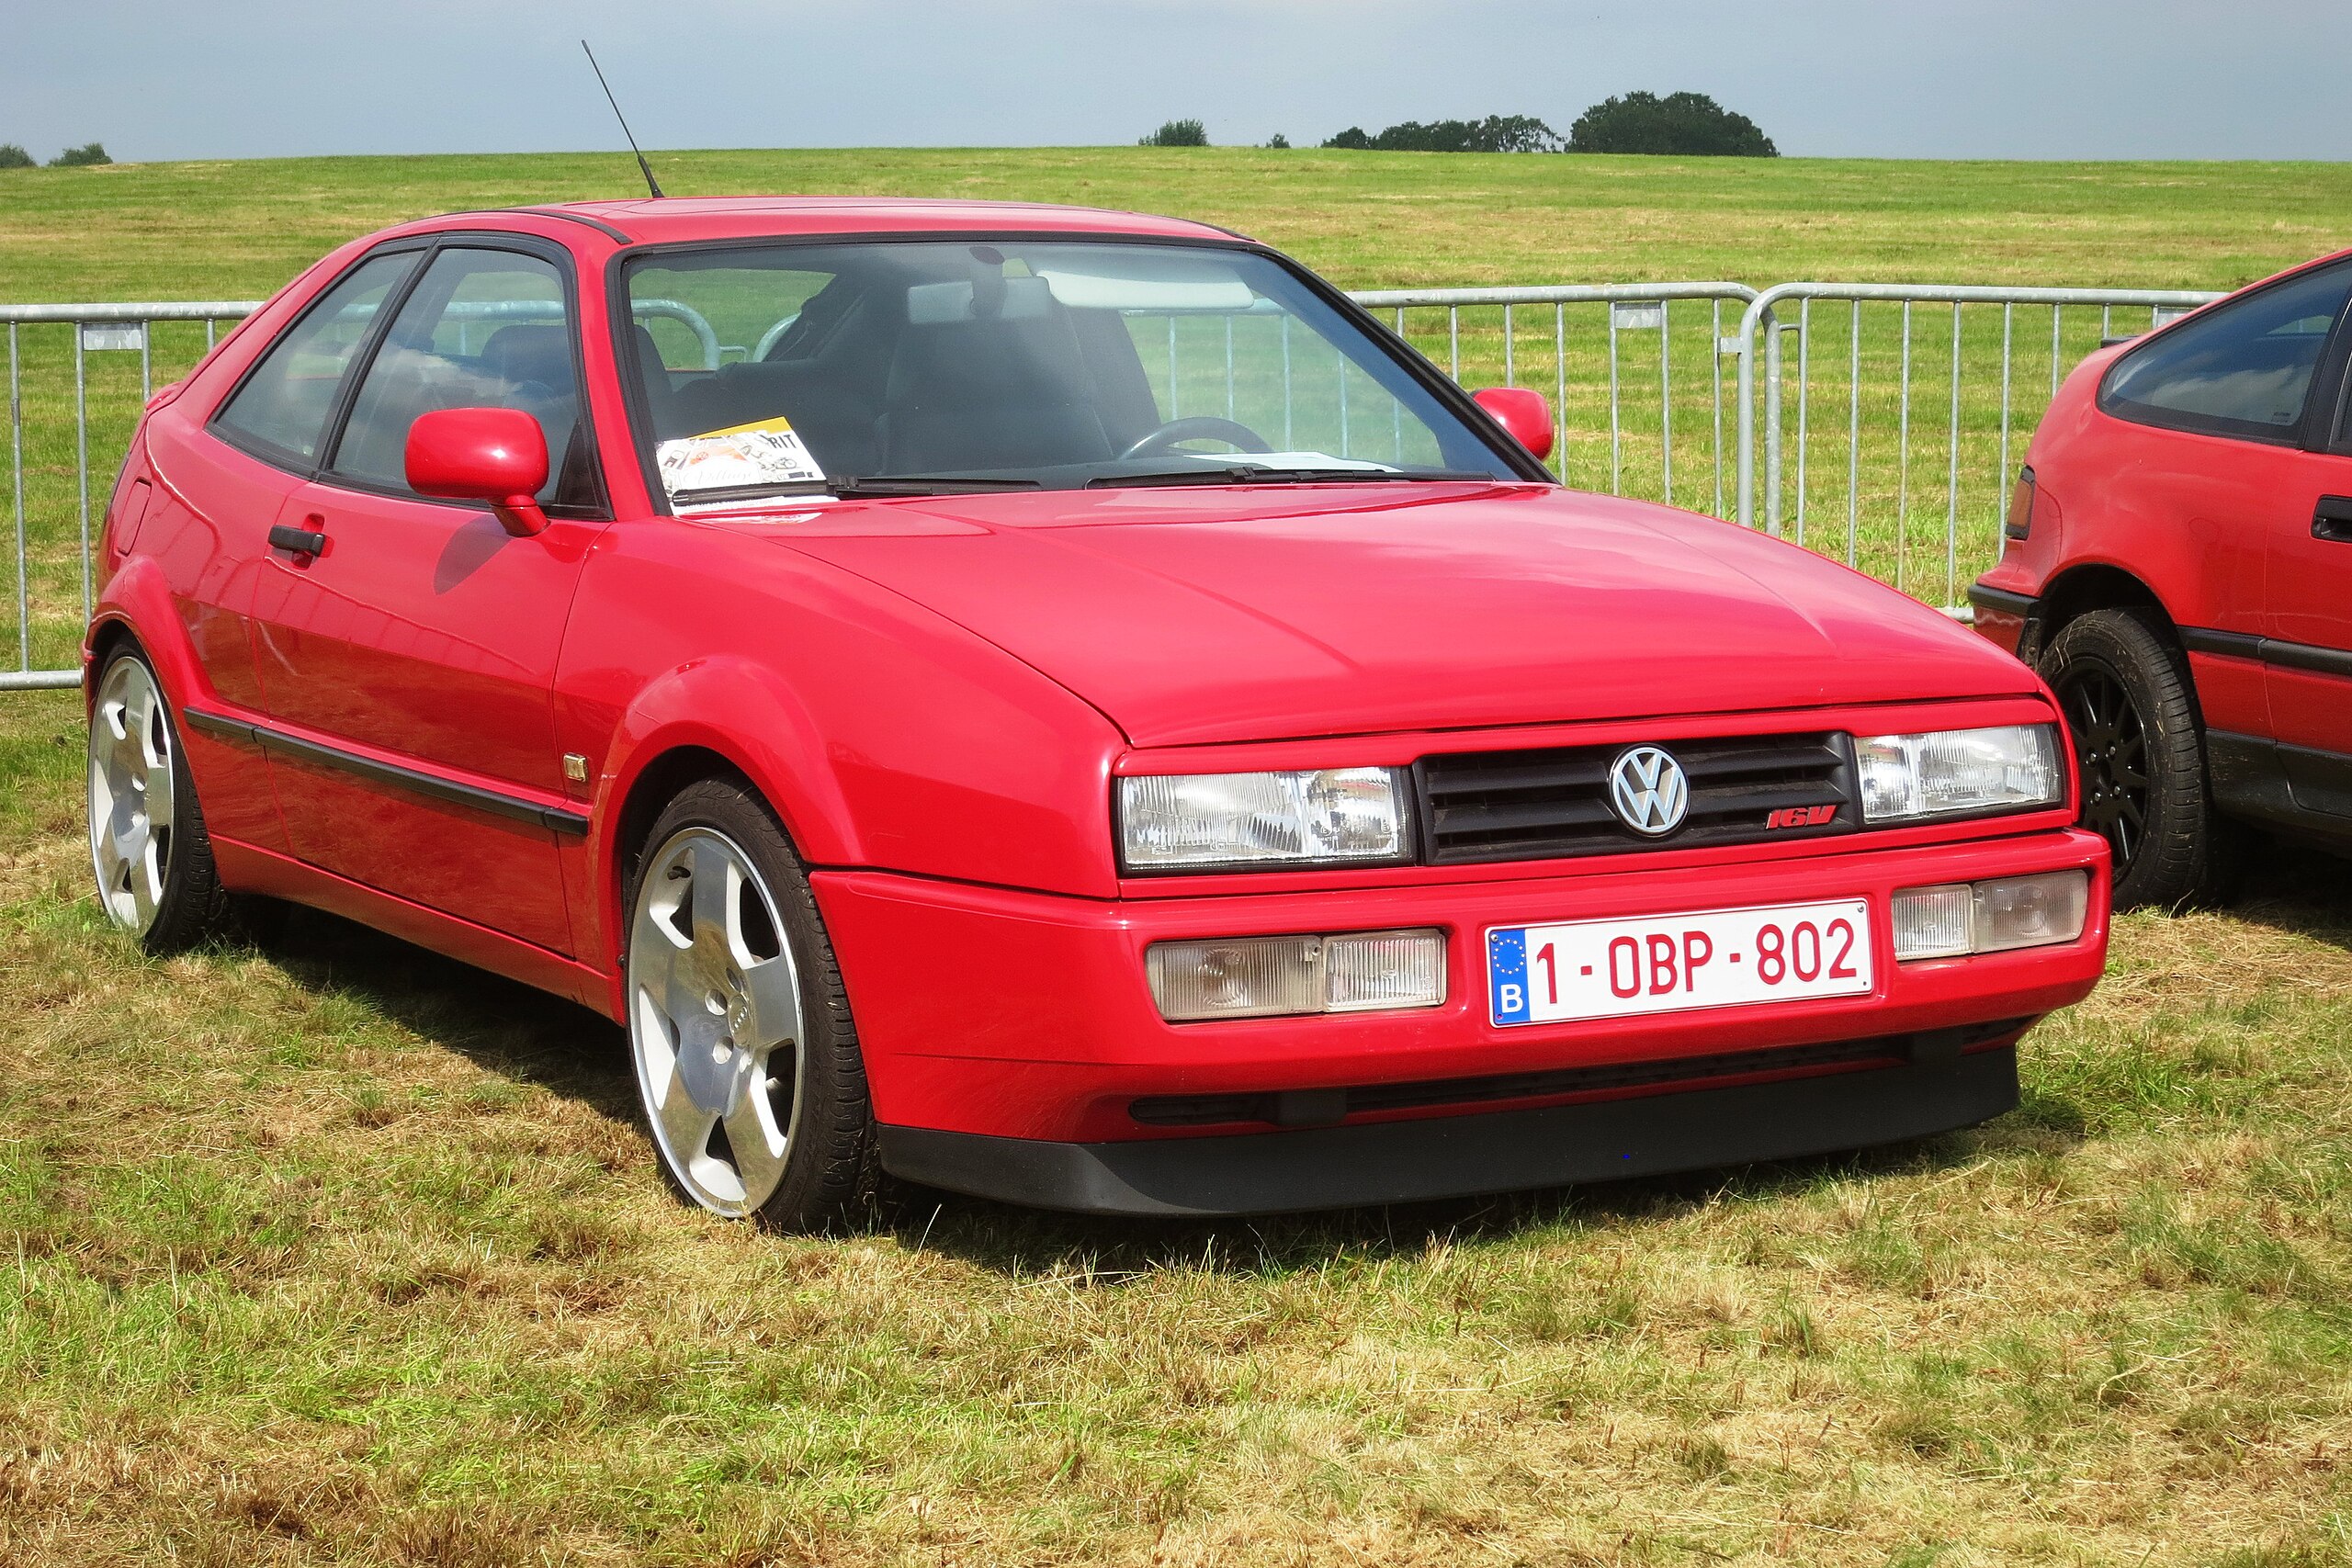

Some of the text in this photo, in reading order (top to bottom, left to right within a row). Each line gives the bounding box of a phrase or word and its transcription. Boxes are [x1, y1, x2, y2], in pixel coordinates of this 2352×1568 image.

[1612, 747, 1689, 833] VW
[1766, 805, 1837, 829] 16V
[1500, 984, 1523, 1013] B
